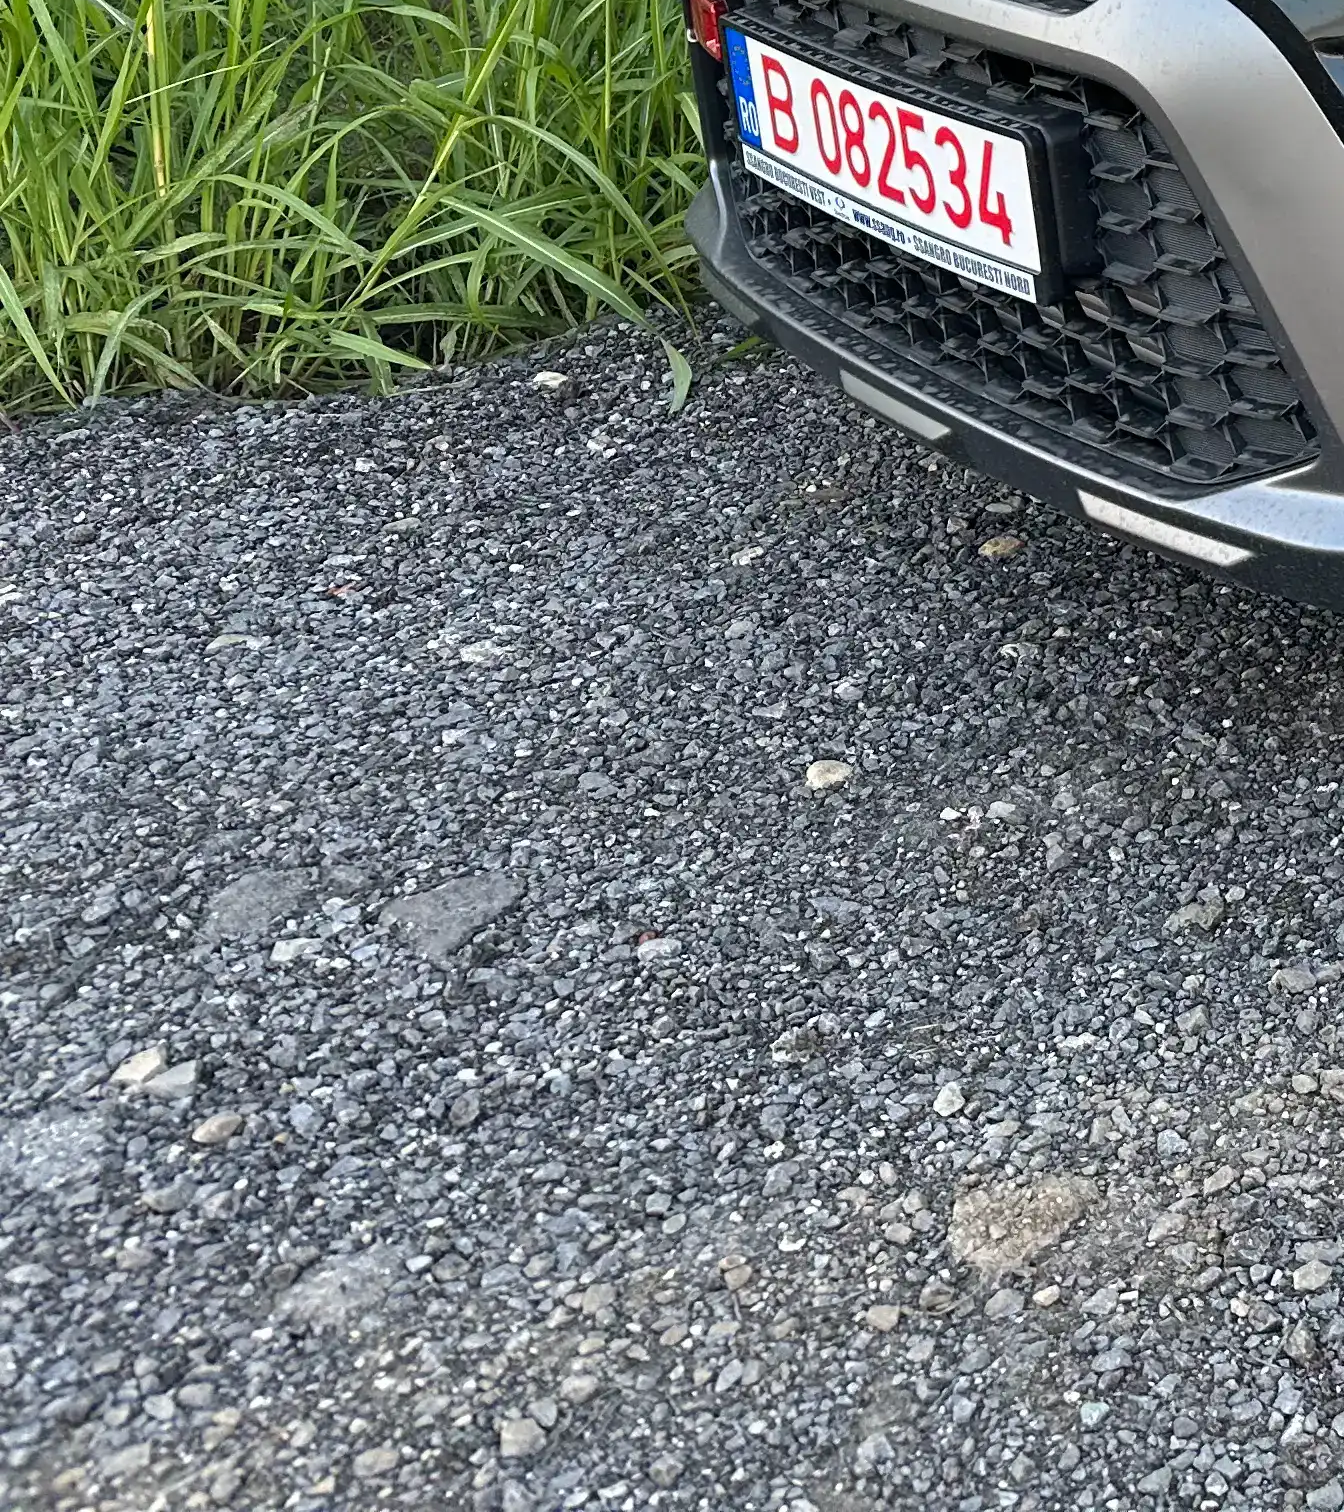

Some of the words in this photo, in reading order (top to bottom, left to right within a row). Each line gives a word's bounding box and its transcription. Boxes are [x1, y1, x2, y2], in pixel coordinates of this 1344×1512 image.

[738, 95, 760, 137] RO
[760, 52, 800, 155] B
[810, 76, 1014, 247] 082534
[810, 185, 827, 206] VEST
[852, 208, 906, 245] www.ssang.ro
[913, 234, 952, 266] SSANGRO
[953, 251, 1003, 286] BUCURESTI
[1003, 271, 1031, 296] NORD
